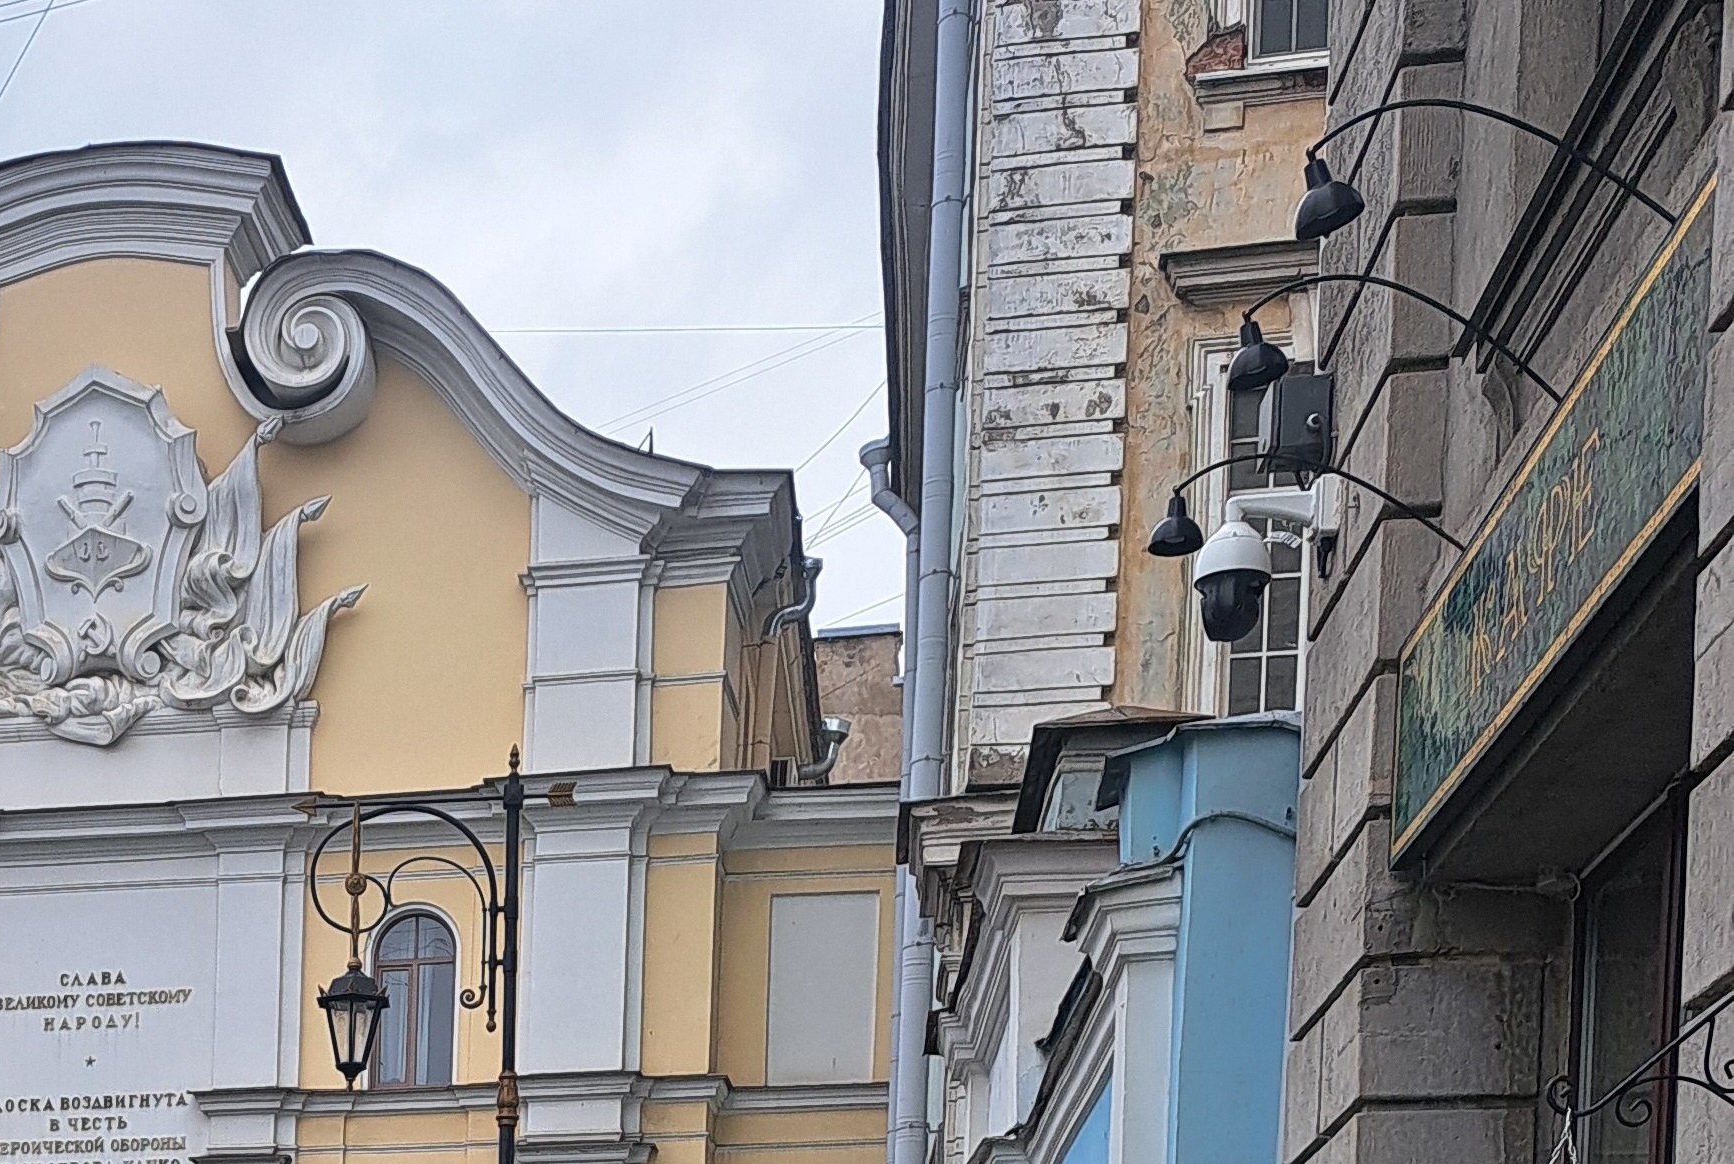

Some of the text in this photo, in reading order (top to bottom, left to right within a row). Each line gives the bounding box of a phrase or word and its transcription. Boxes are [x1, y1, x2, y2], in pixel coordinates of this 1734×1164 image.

[1468, 427, 1601, 698] КАФЕ
[60, 970, 127, 987] СЛАВА
[85, 989, 192, 1008] СОВЕТСКОМУ
[43, 1012, 140, 1031] НАРОДУ!
[60, 1092, 189, 1111] ВОЗДВИГНУТА
[49, 1116, 128, 1132] В ЧЕСТЬ
[110, 1136, 186, 1152] ОБОРОНЫ
